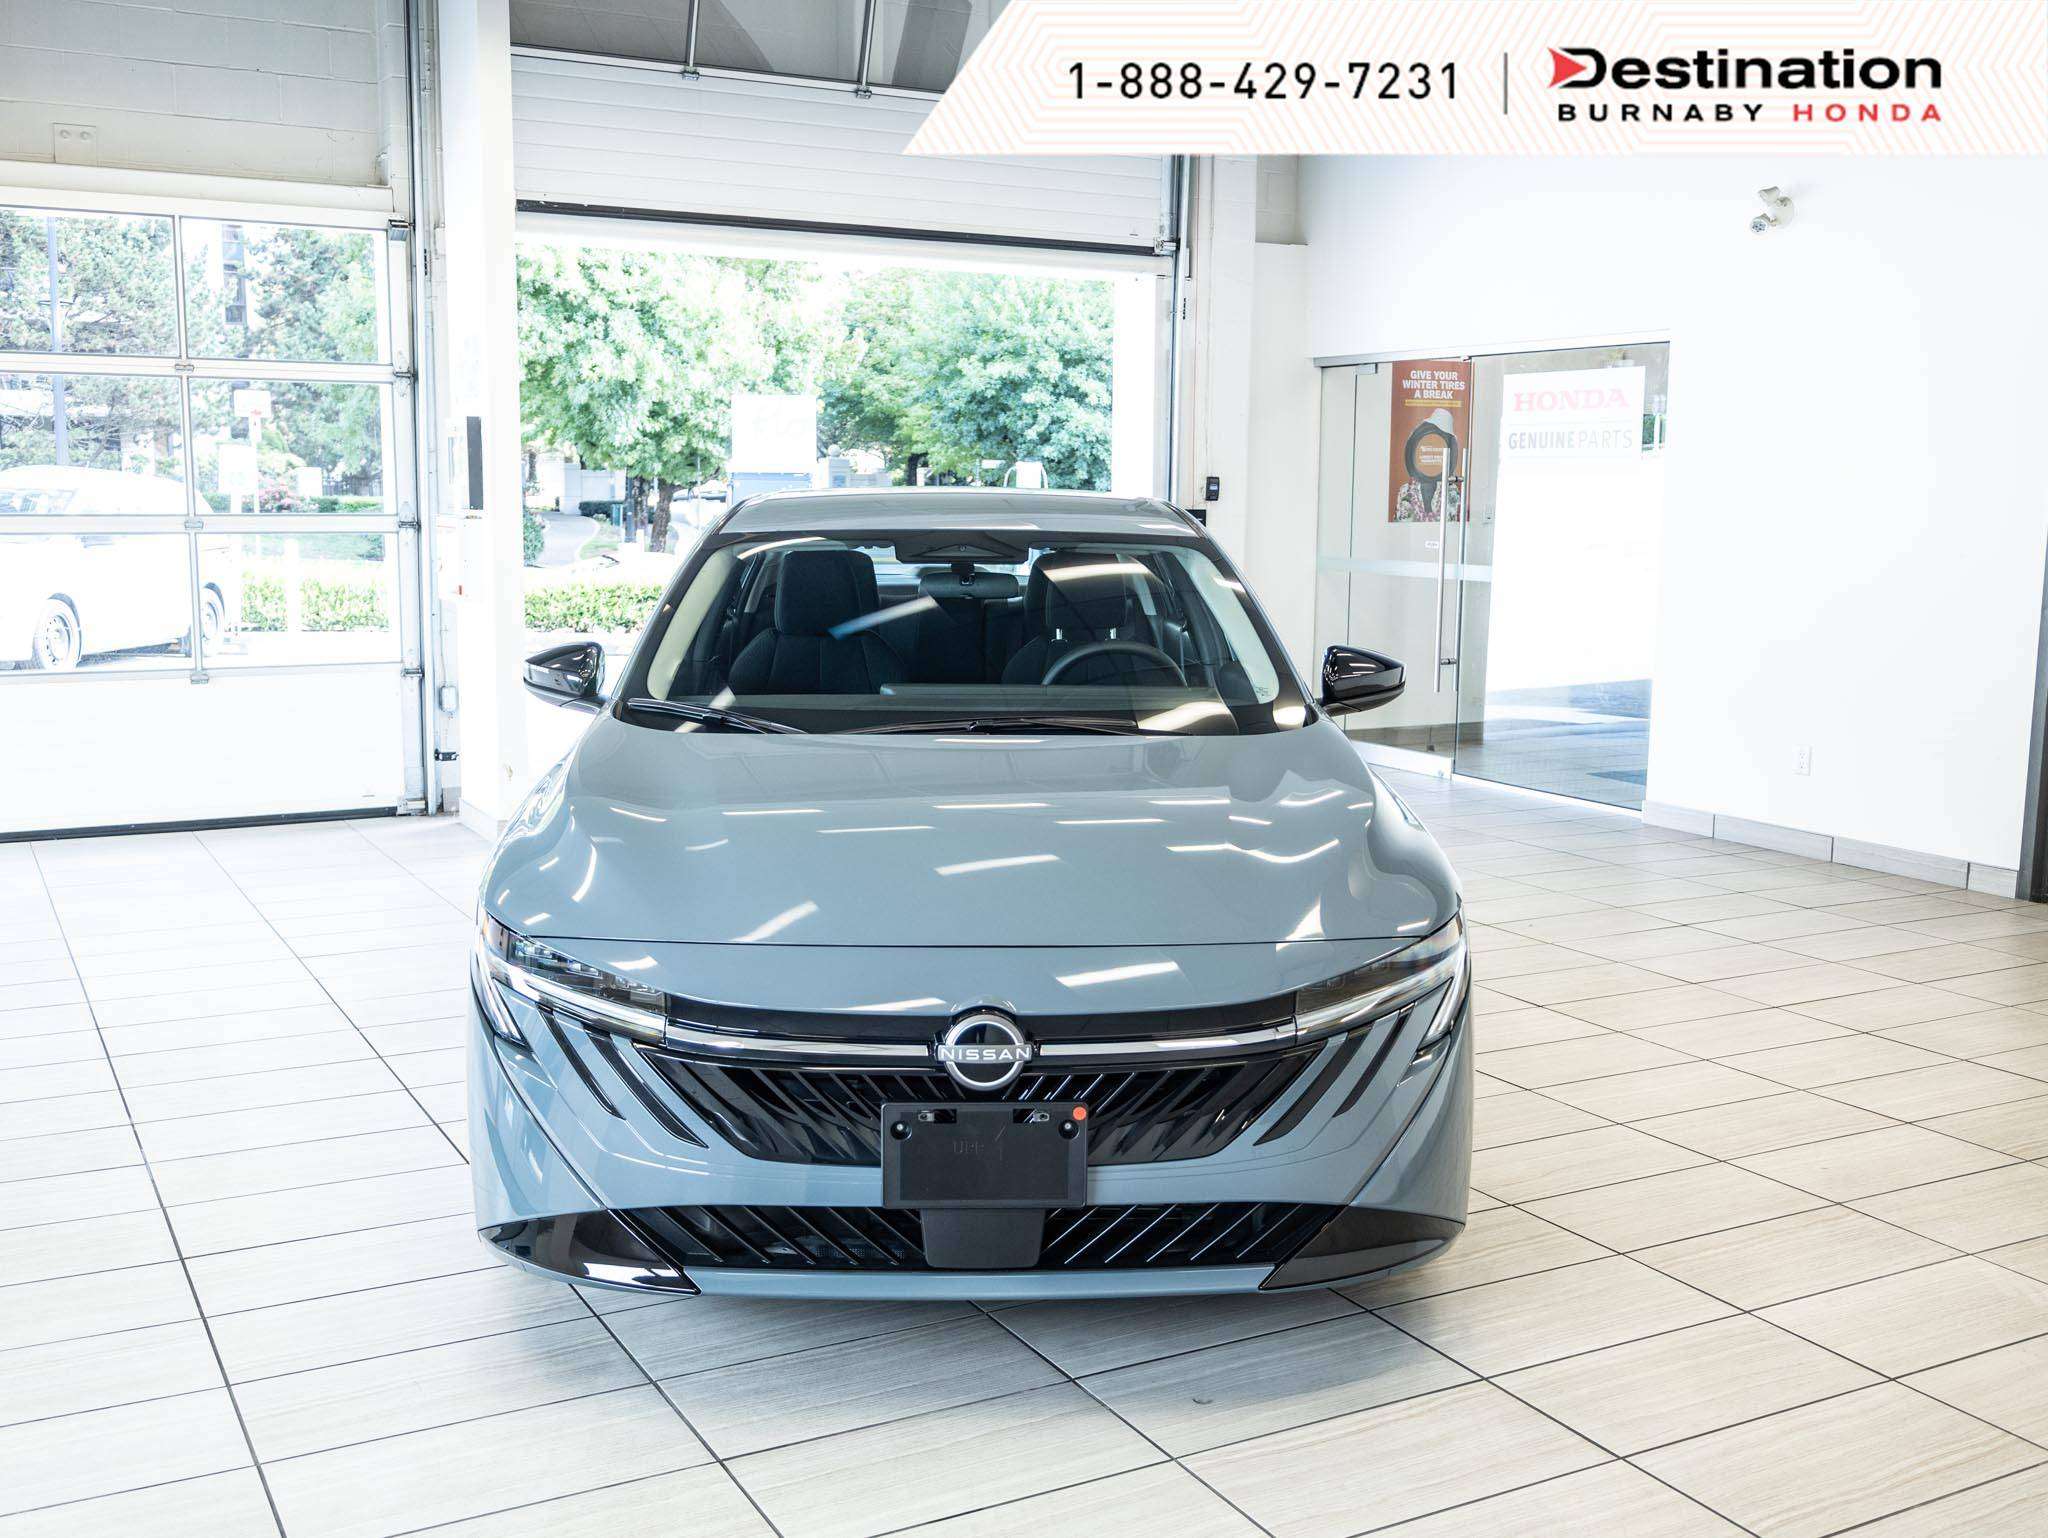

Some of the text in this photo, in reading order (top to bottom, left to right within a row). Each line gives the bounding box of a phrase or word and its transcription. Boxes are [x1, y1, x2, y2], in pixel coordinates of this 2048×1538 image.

[1410, 370, 1458, 380] GIVE YOUR
[1402, 379, 1466, 390] WINTER TIRES
[1414, 389, 1453, 399] A BREAK
[1512, 387, 1630, 412] HONDA
[940, 1047, 1031, 1061] NISSAN
